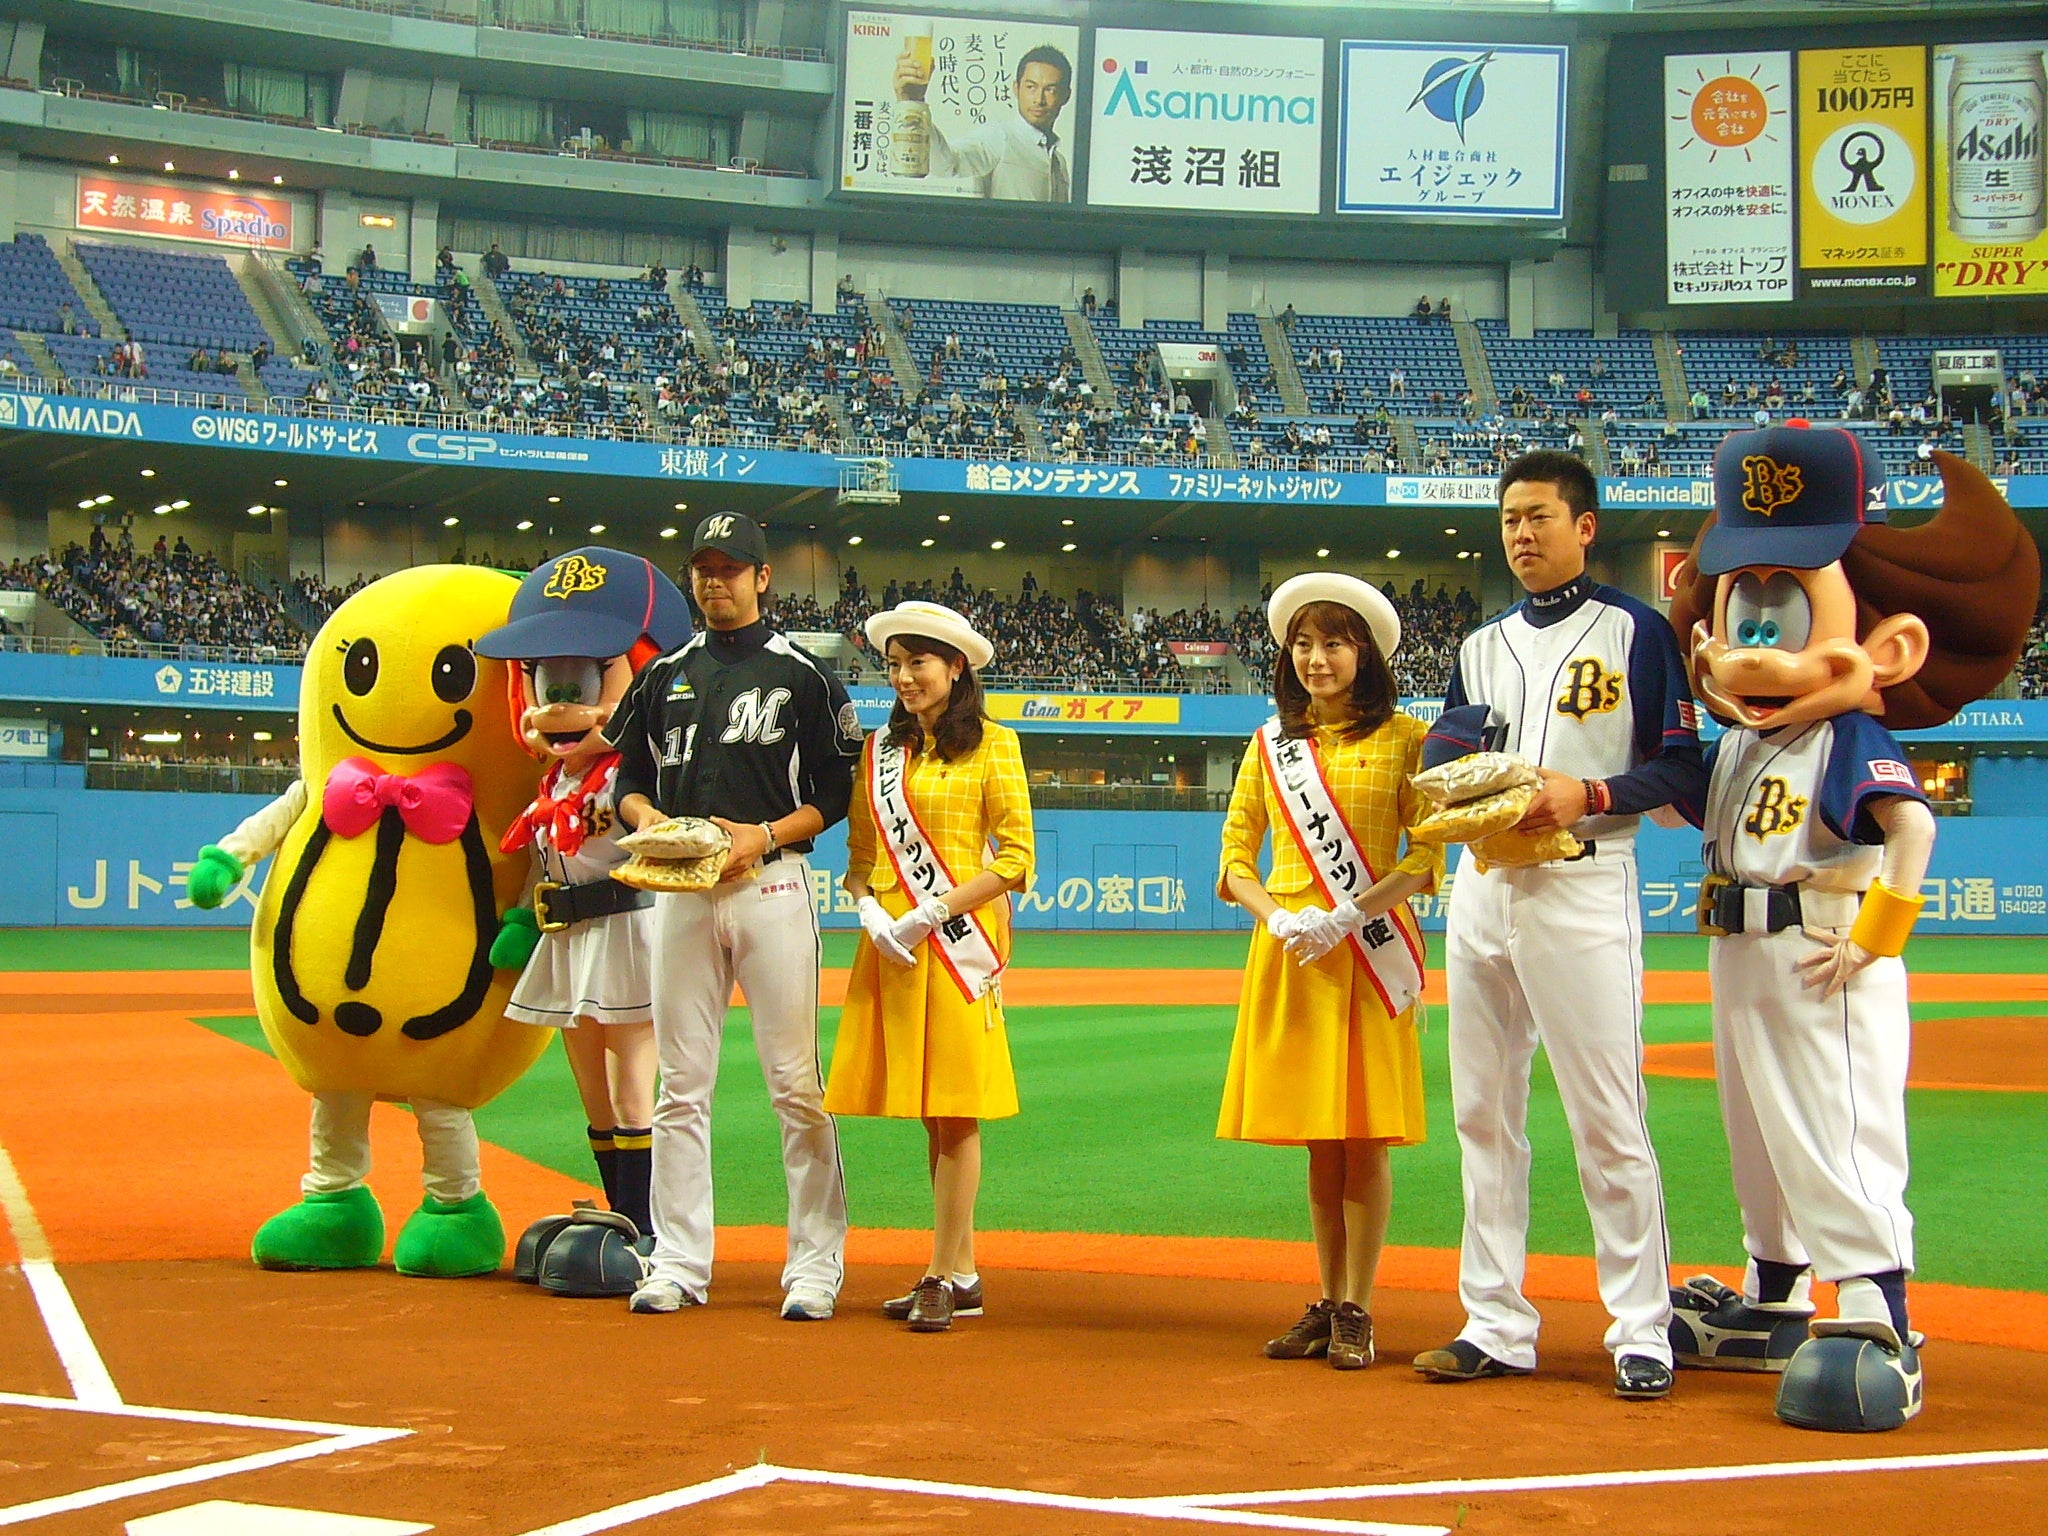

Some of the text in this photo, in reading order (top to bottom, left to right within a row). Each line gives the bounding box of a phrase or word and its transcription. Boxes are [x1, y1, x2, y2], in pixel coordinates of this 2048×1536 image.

[853, 24, 890, 37] KIRIN
[1841, 54, 1884, 68] ここに
[1833, 68, 1892, 84] 当てたら
[1103, 66, 1316, 125] Asanuma
[1711, 90, 1748, 104] 会社を
[1817, 86, 1914, 113] 100万円
[1703, 107, 1757, 121] 元気にする
[852, 100, 874, 172] 一番搾り
[1716, 123, 1745, 137] 会社
[1957, 122, 2038, 162] Asahi
[1406, 148, 1498, 163] 人材総合商社
[1379, 164, 1523, 188] エイジェック
[1985, 168, 2010, 188] 生
[1417, 189, 1487, 204] グループ
[1672, 184, 1787, 200] オフィスの中を快適に。
[1832, 195, 1895, 209] MONEX
[82, 189, 194, 226] 天然温泉
[1672, 202, 1787, 218] オフィスの外を安全に。
[200, 208, 287, 239] Spadio
[1820, 246, 1905, 260] マネックス証券
[1972, 246, 2024, 259] SUPER
[1673, 255, 1788, 276] 株式会社 トップ
[1673, 278, 1788, 292] セキュリティハウス TOP
[1810, 275, 1917, 288] www.monex.co.jp
[1198, 351, 1216, 362] 3M
[20, 395, 143, 437] YAMADA
[216, 417, 378, 455] WSG ワールドサービス
[407, 433, 497, 461] CSP
[657, 447, 757, 478] 東横イン
[966, 464, 1140, 495] 総合メンテナンス
[1169, 473, 1342, 500] ファミリーネット・ジャパン
[1605, 481, 1716, 506] Machida町
[703, 515, 736, 541] M
[187, 667, 275, 698] 五洋建設
[719, 687, 792, 745] M
[1066, 698, 1144, 720] ガイア
[1969, 711, 2024, 726] TIARA
[2015, 885, 2043, 898] 0120
[2000, 900, 2047, 914] 154022
